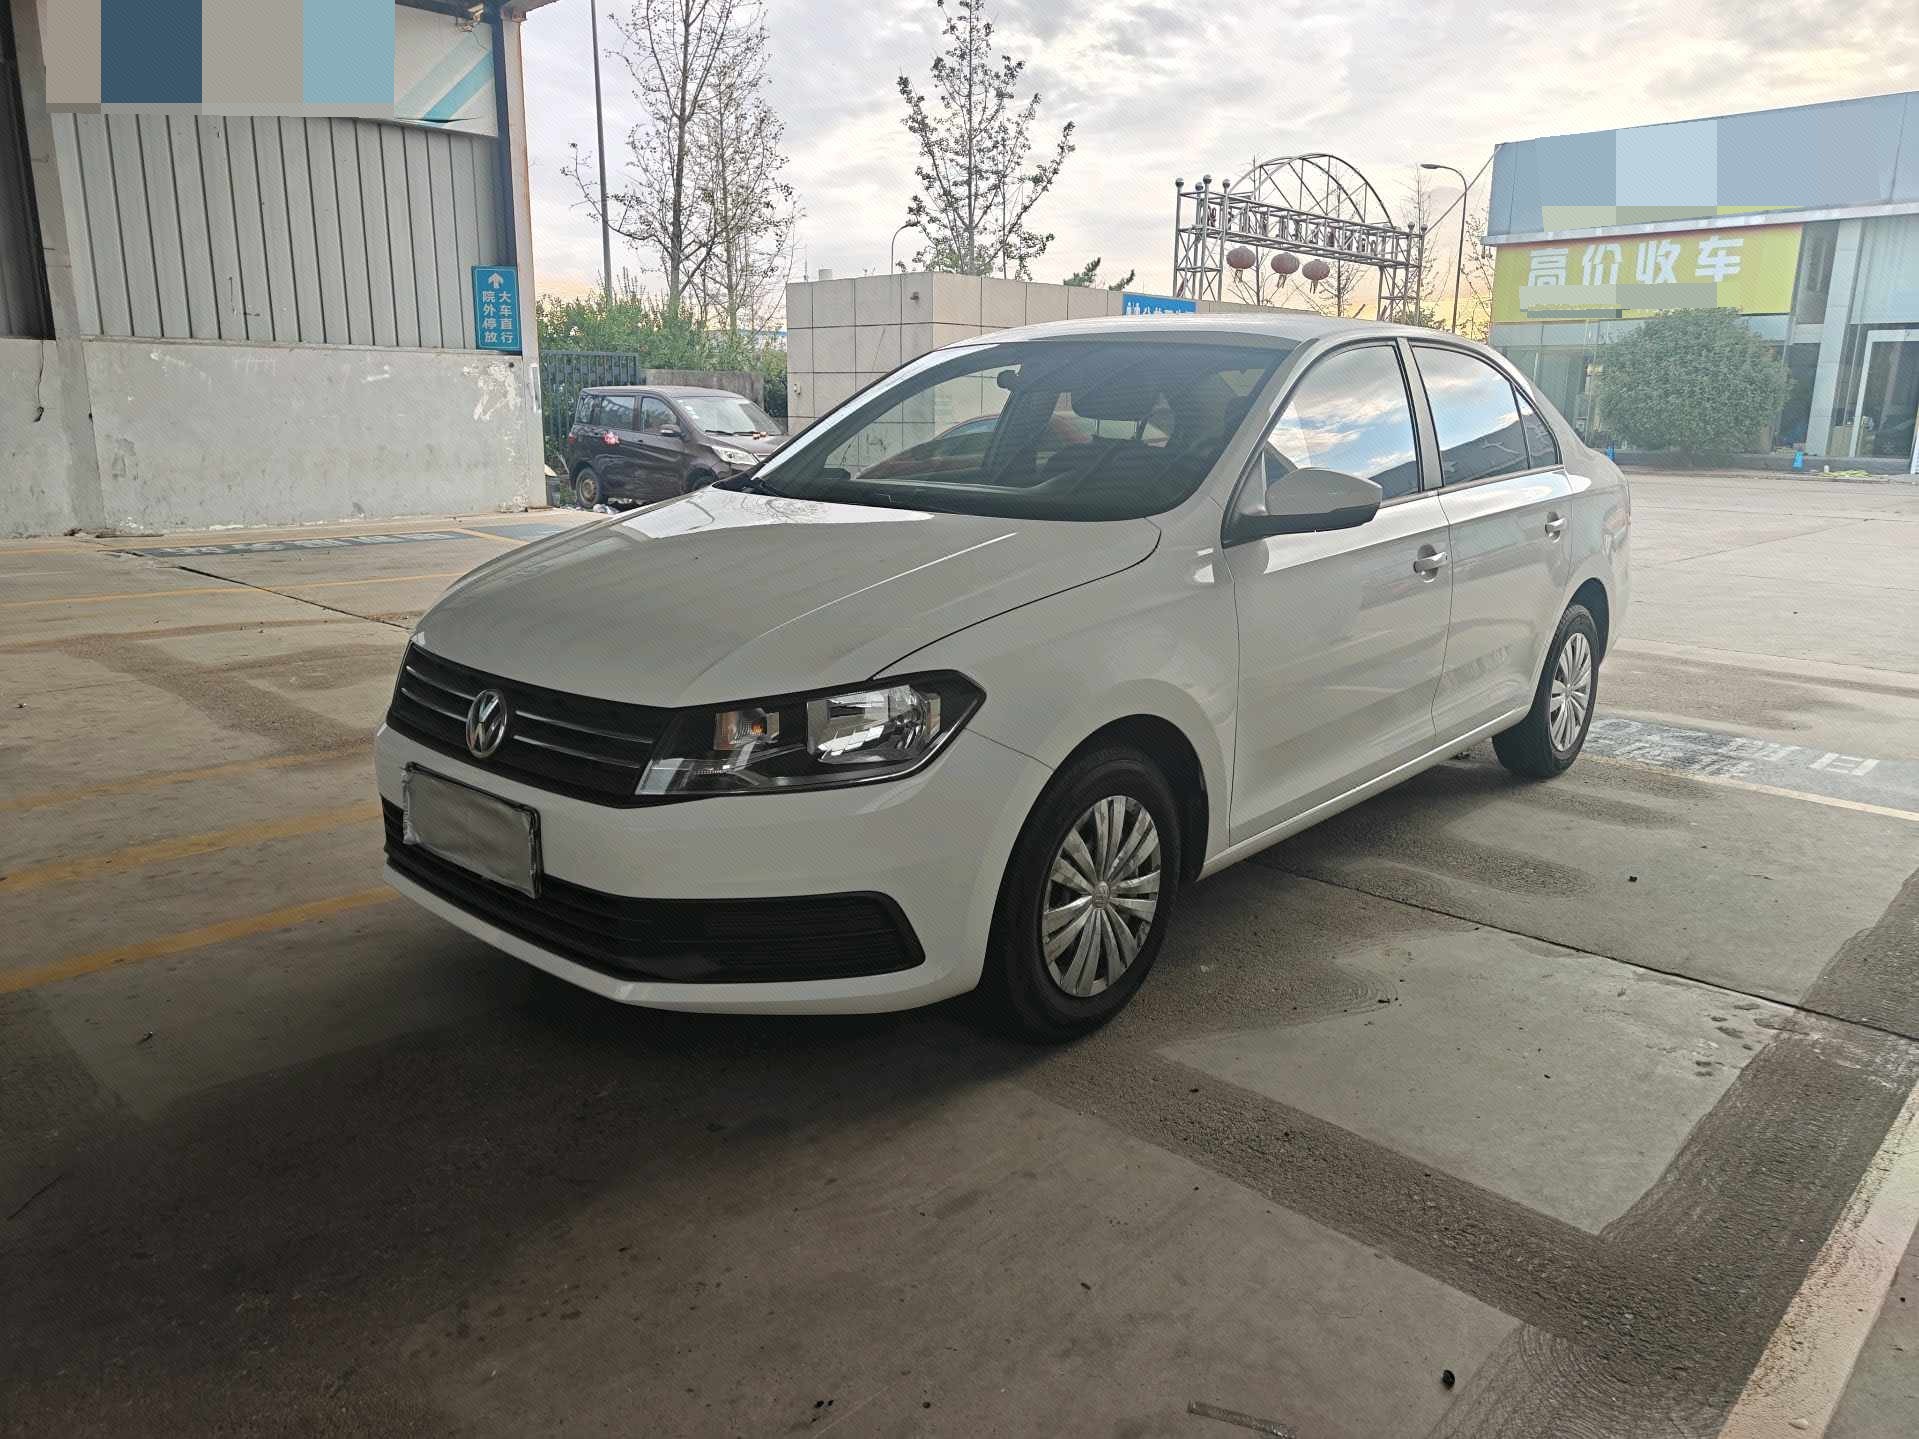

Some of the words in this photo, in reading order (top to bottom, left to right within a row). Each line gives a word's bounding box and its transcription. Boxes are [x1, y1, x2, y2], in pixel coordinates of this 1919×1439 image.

[1527, 235, 1744, 287] 高价收车
[481, 291, 498, 343] 院外停放
[498, 291, 513, 343] 大车直行
